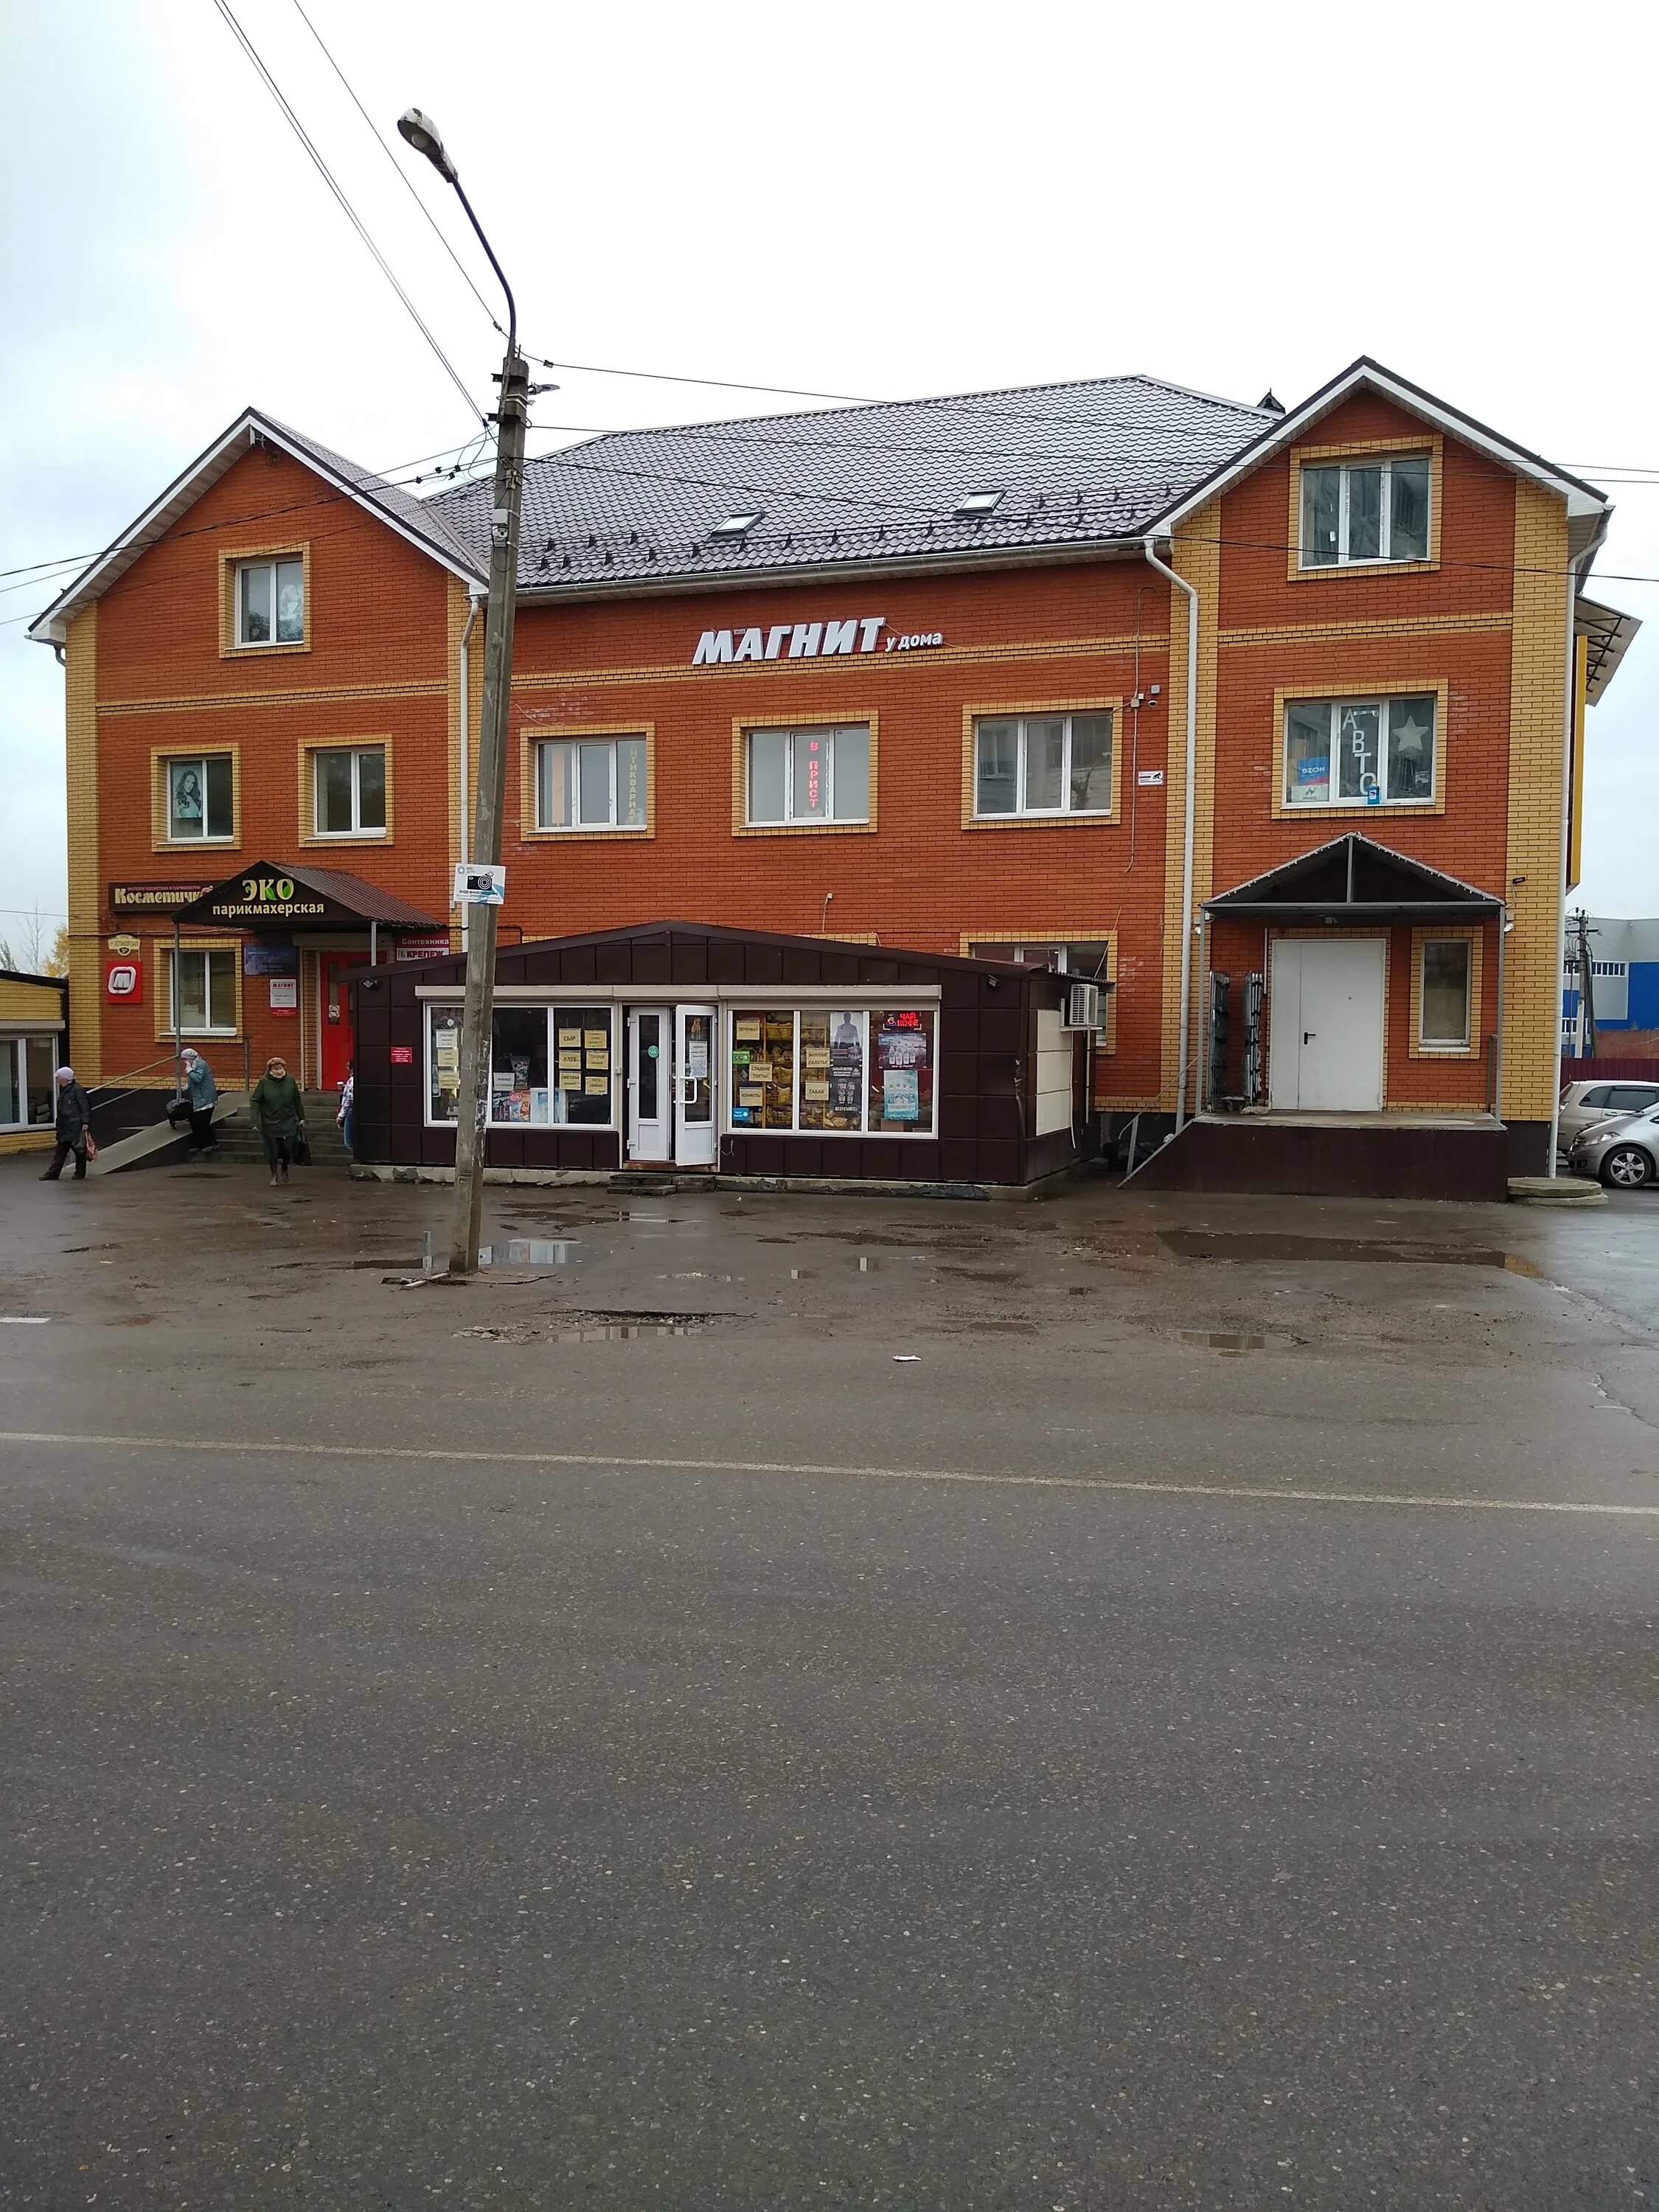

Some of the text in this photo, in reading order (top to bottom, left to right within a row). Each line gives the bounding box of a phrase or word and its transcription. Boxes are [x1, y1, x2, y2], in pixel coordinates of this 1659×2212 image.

[692, 617, 943, 664] МАГНИТ у дома
[115, 888, 201, 904] Косметичк
[242, 878, 294, 901] ЭКО
[212, 903, 324, 918] парикмахерская
